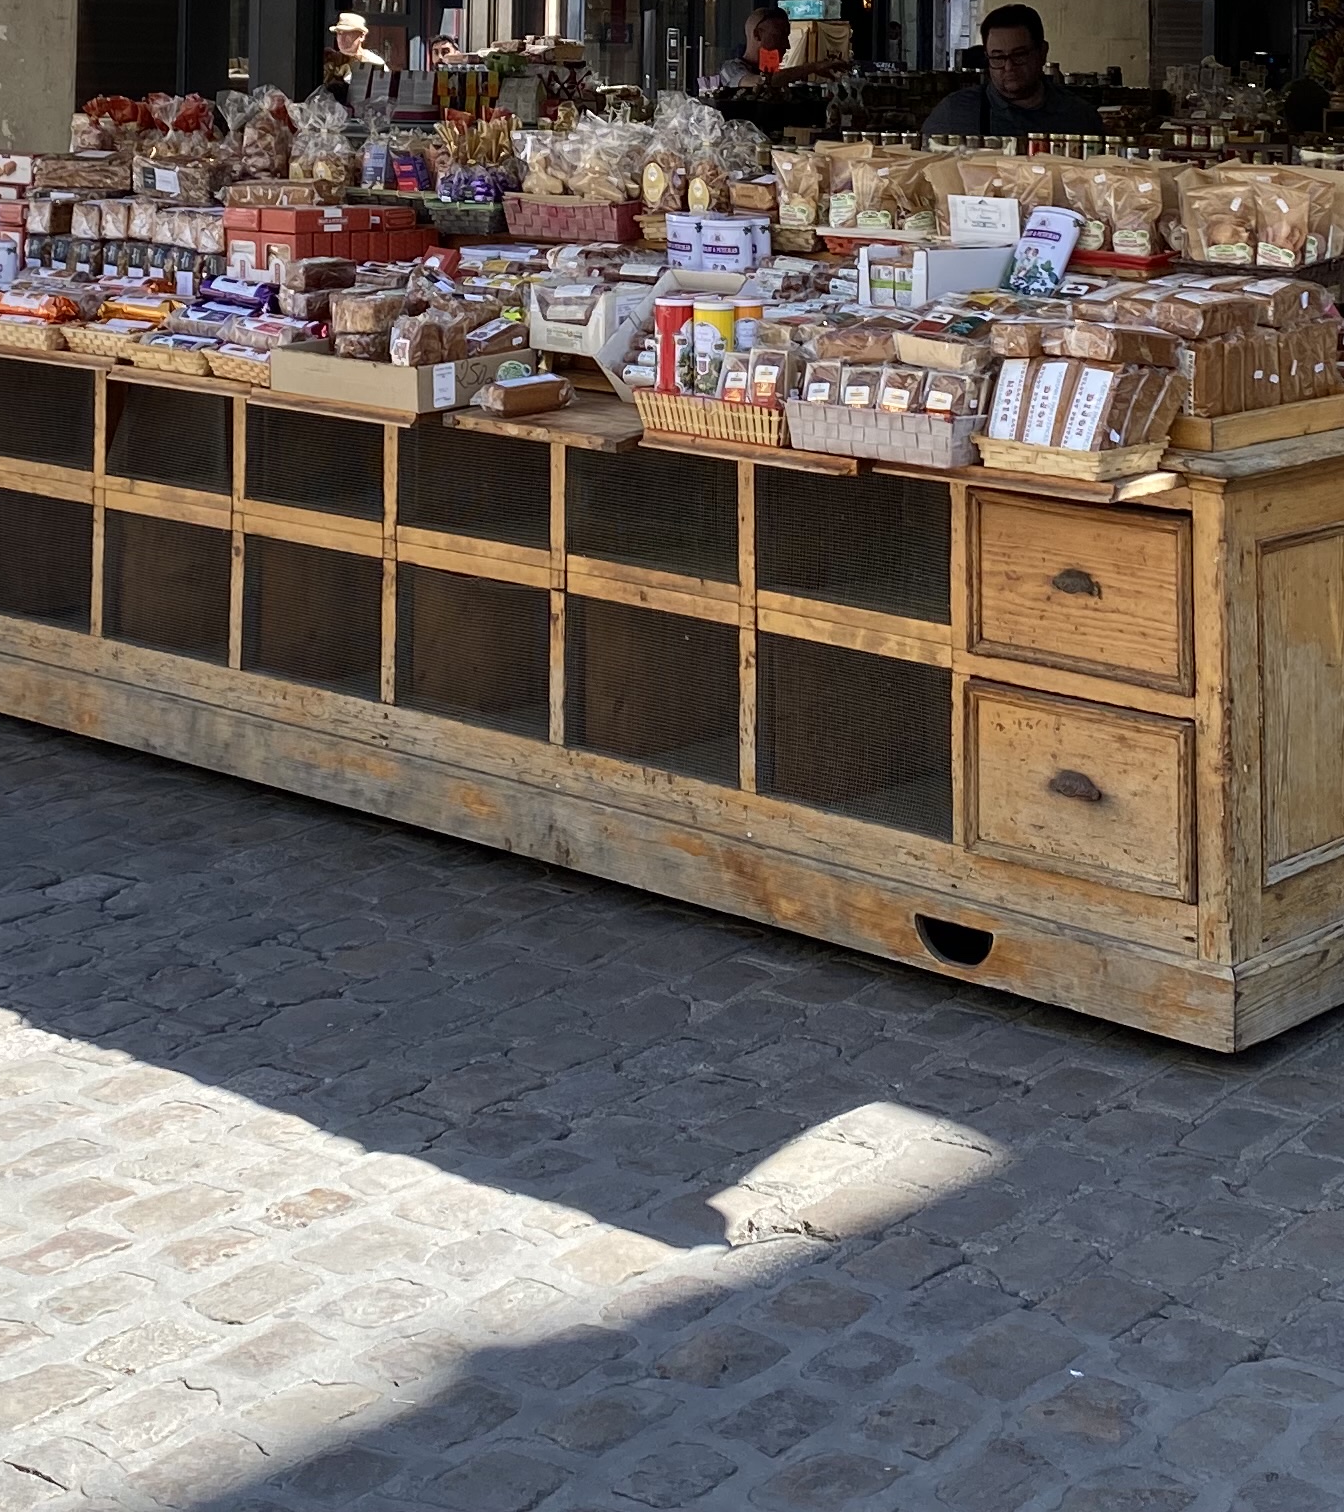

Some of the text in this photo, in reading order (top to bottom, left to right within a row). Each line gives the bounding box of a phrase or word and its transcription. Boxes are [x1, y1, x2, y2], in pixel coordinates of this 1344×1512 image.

[999, 380, 1015, 422] DIJON
[1036, 384, 1052, 428] DIJON
[1074, 392, 1096, 438] DIJON
